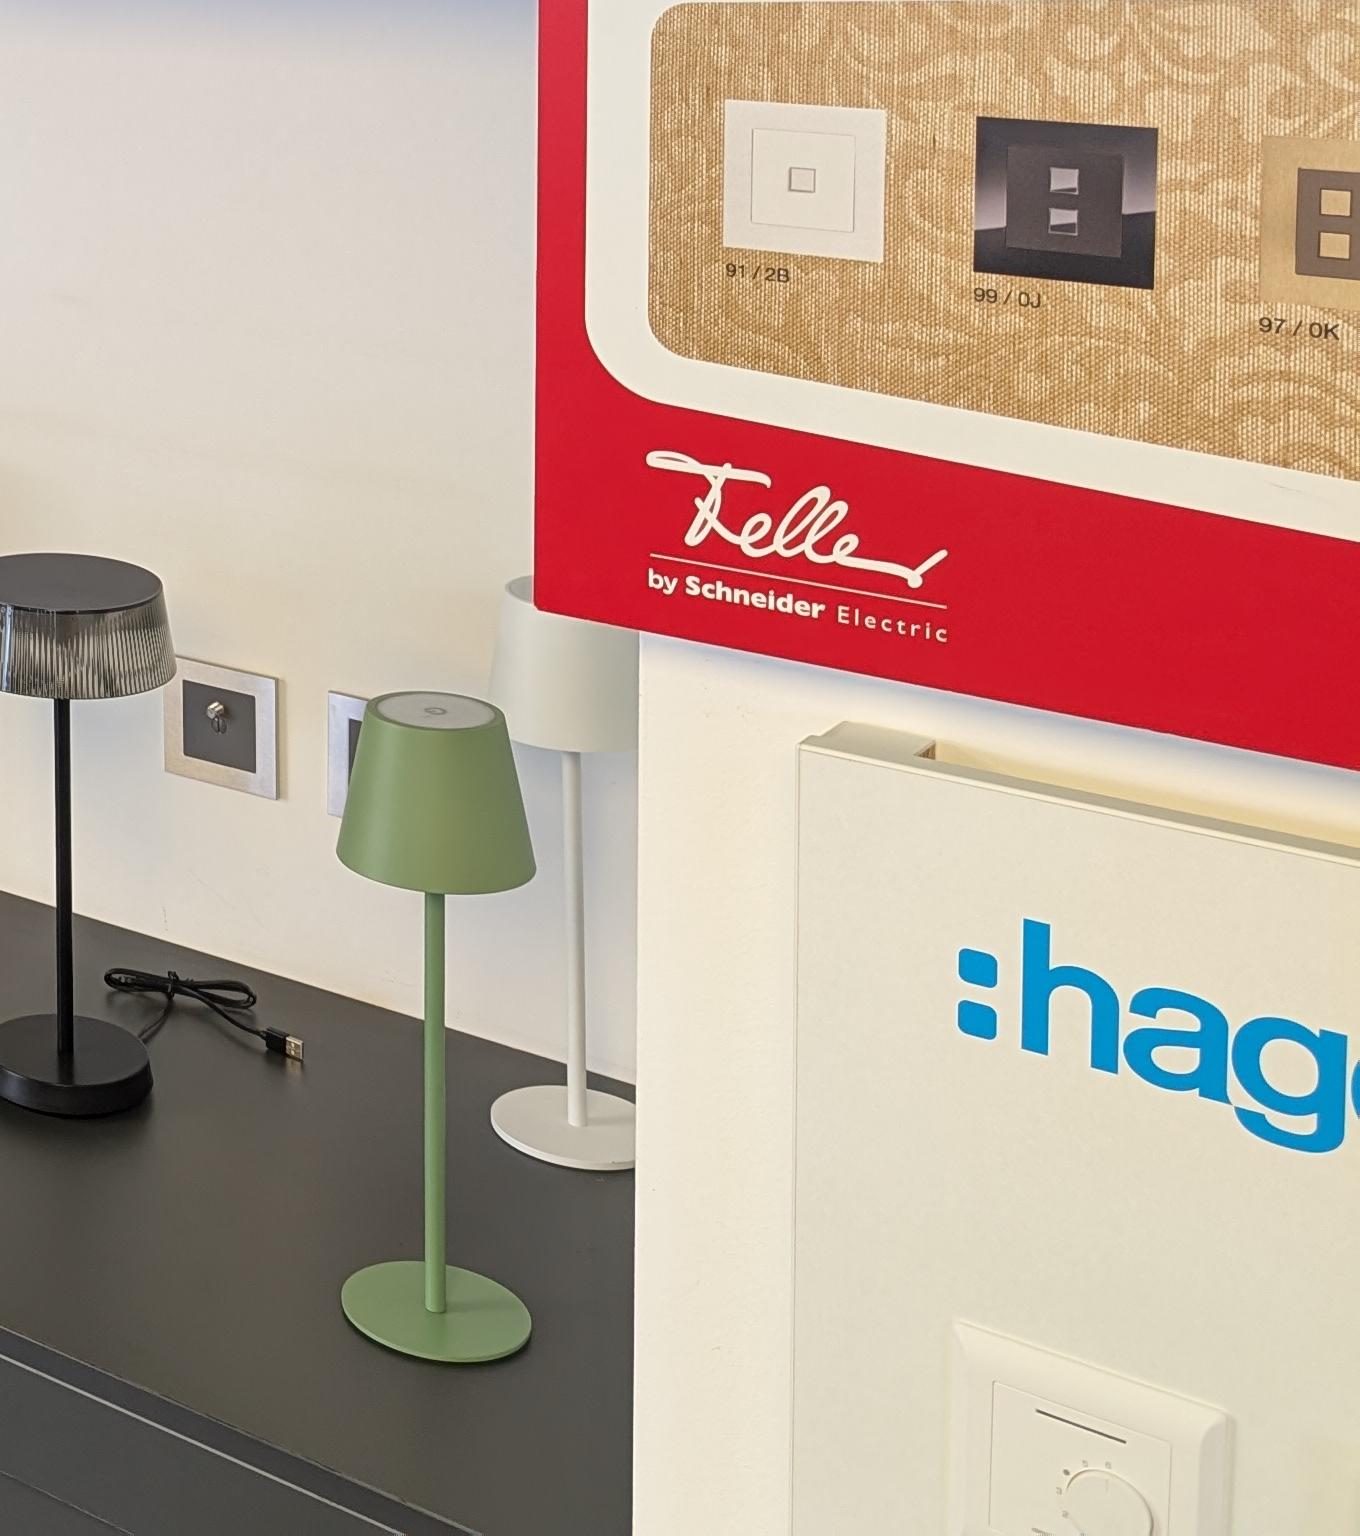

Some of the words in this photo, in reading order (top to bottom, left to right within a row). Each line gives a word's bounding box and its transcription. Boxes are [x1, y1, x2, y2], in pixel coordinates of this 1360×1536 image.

[725, 263, 746, 278] 91
[765, 267, 790, 283] 2B
[973, 287, 998, 304] 99
[1259, 317, 1287, 334] 97
[1293, 320, 1303, 336] /
[647, 567, 679, 596] by
[685, 575, 826, 619] Schneider
[837, 605, 948, 643] Electric
